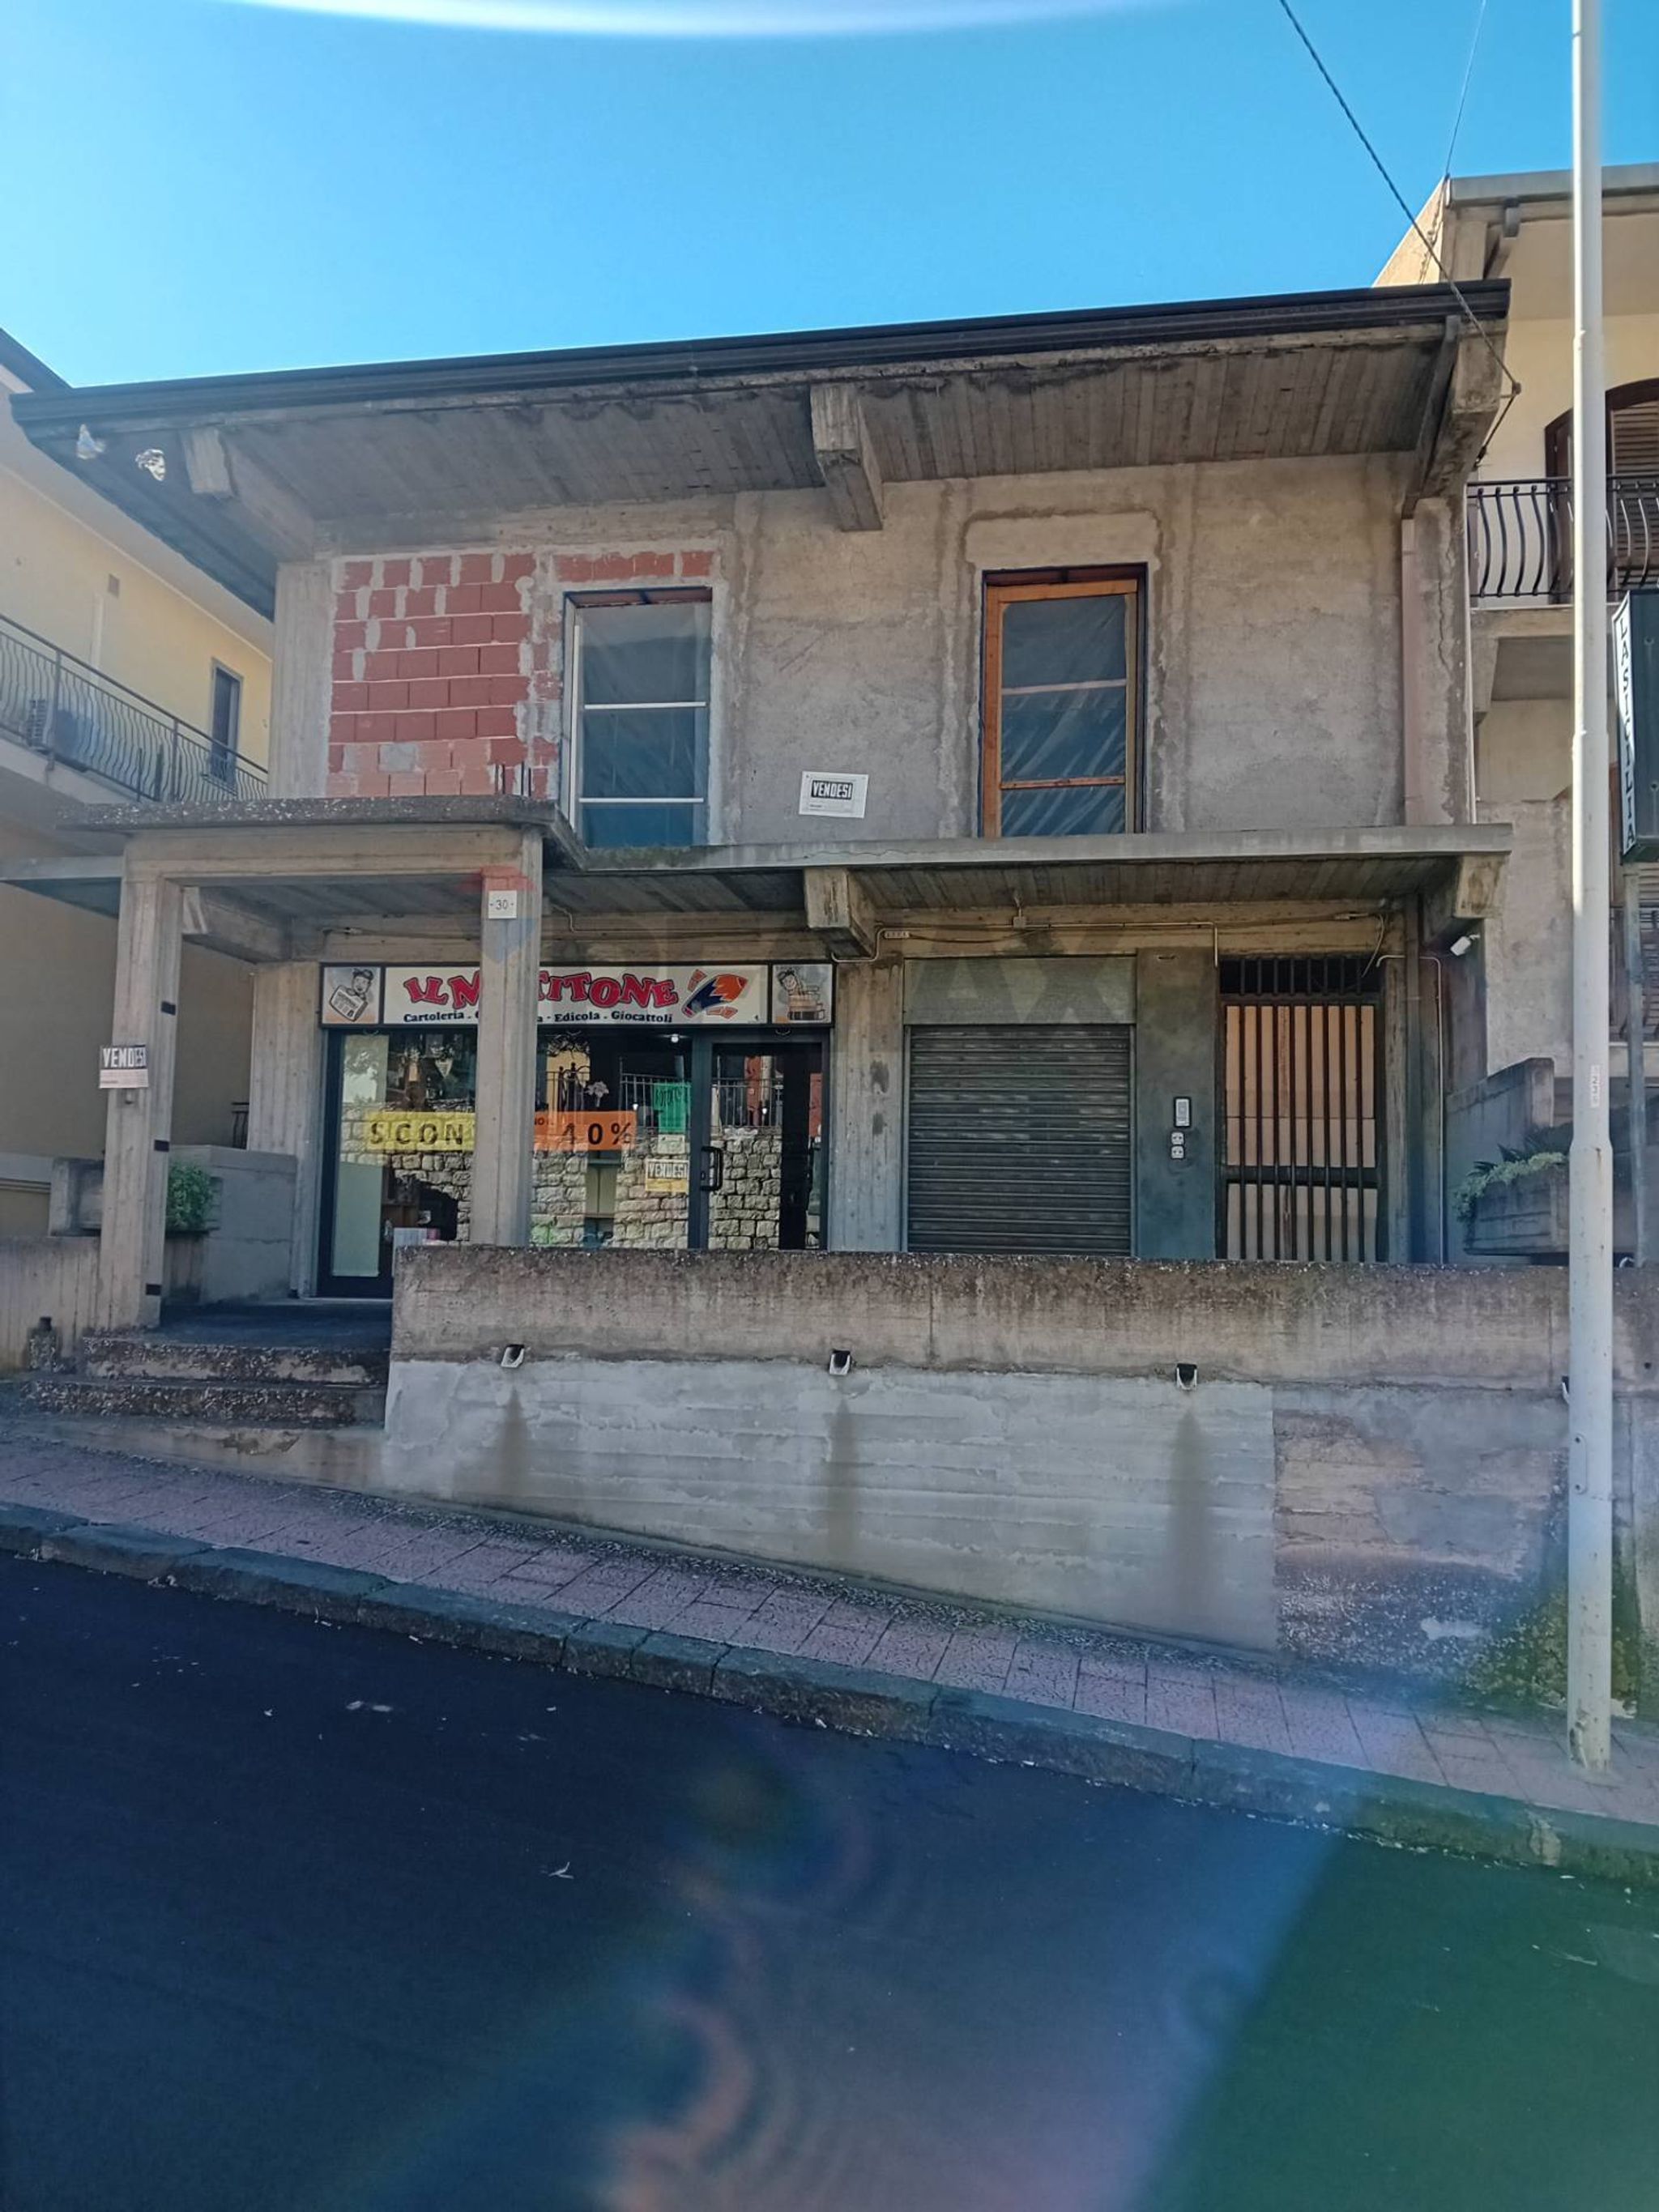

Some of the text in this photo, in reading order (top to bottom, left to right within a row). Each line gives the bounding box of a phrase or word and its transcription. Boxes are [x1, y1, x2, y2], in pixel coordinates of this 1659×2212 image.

[812, 782, 852, 799] VENDESI
[495, 899, 509, 910] 30
[403, 975, 450, 1006] IL
[403, 1010, 465, 1022] Cartoleria
[554, 1011, 600, 1022] Edicola
[611, 1010, 673, 1022] Giocattoli
[102, 1047, 147, 1068] VENDESI
[370, 1122, 476, 1145] SCON
